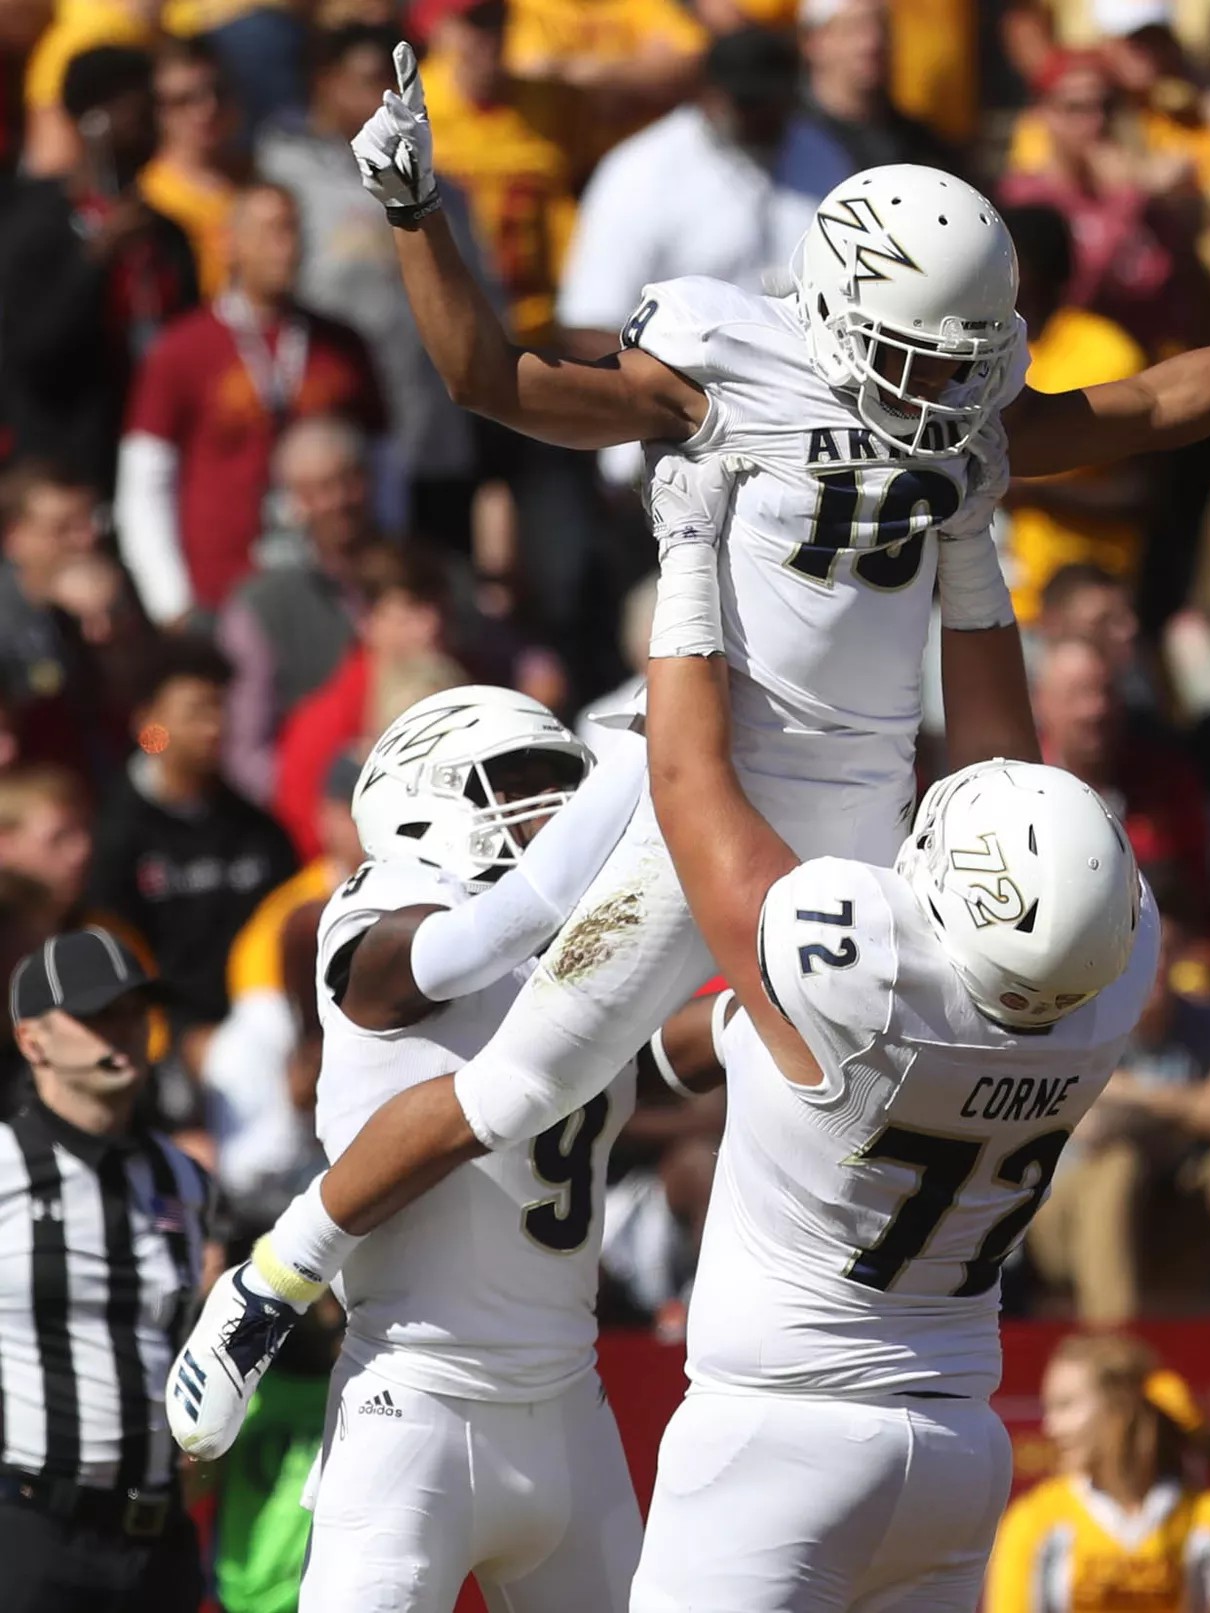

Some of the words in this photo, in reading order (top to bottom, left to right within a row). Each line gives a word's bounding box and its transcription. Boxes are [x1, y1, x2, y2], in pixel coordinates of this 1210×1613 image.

[950, 832, 1025, 930] 72
[796, 899, 861, 979] 72
[959, 1075, 1080, 1121] CORNE
[519, 1088, 613, 1257] 9
[837, 1119, 1075, 1298] 72
[358, 1404, 403, 1418] adidas
